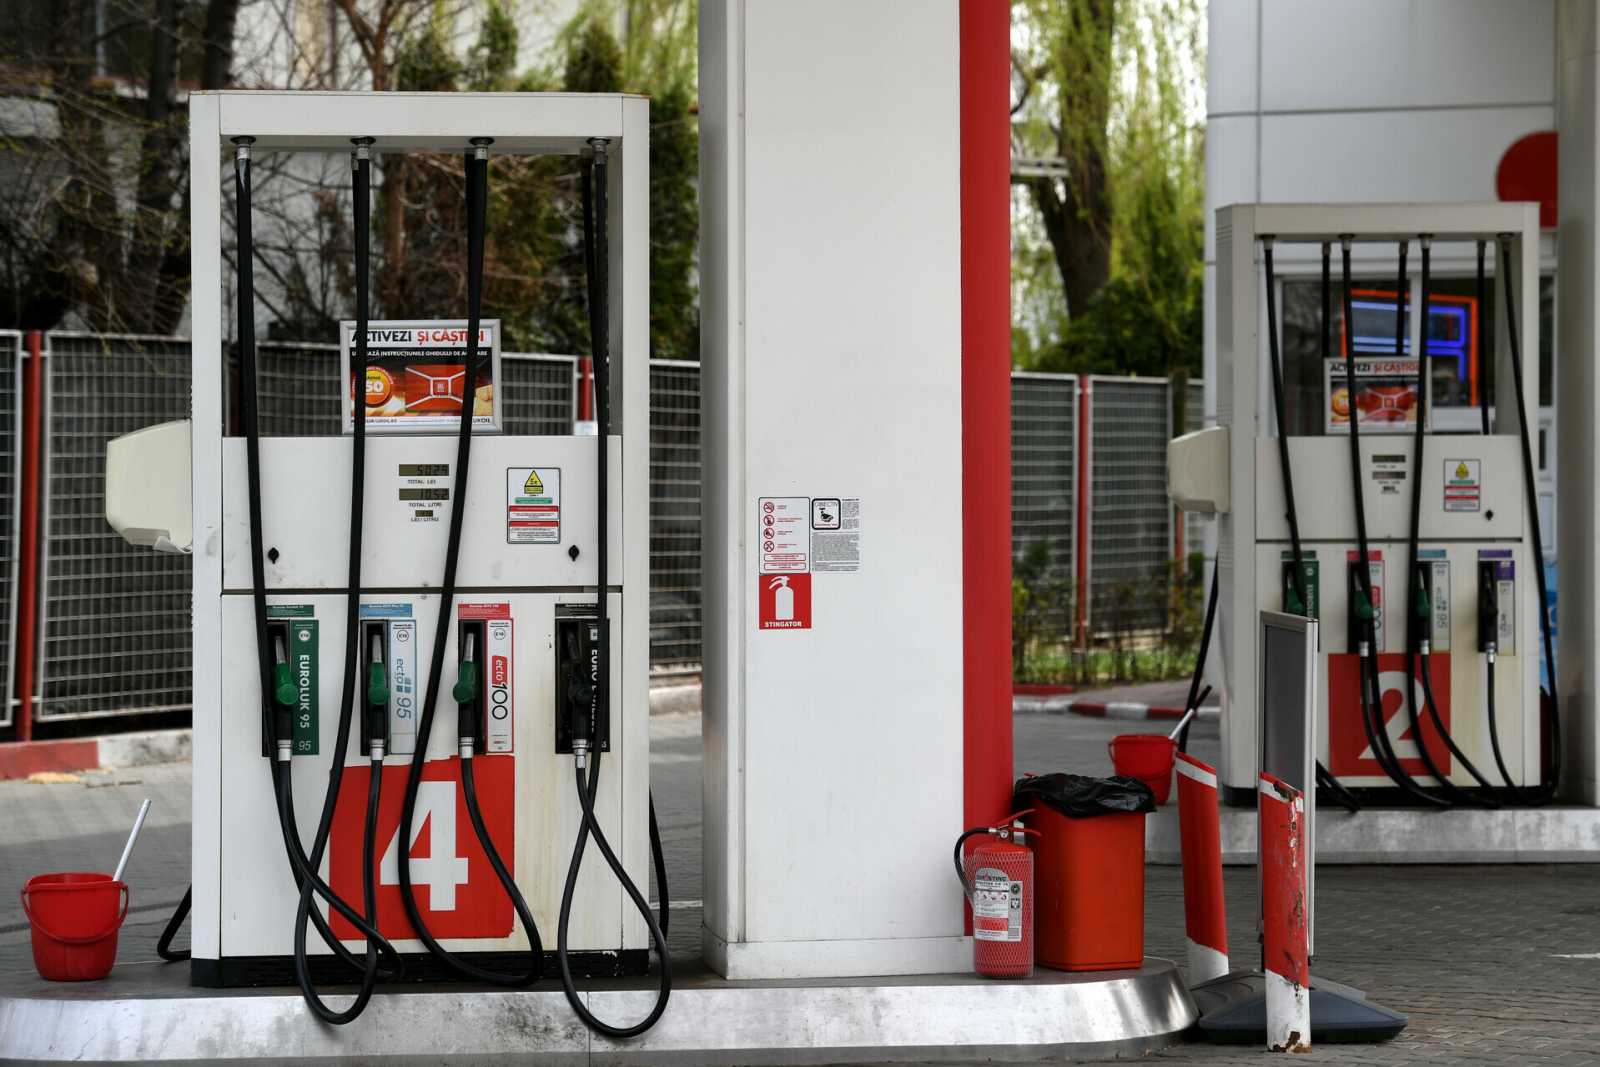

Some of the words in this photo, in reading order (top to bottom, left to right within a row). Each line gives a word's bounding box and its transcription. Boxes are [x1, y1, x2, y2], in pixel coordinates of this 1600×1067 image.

[352, 330, 412, 342] TIVEZI
[432, 328, 484, 346] CÂȘTII
[495, 659, 504, 682] ecto
[299, 654, 310, 711] EUROLUK
[396, 697, 412, 719] 95
[491, 683, 508, 720] 100
[299, 713, 310, 729] 95
[1358, 670, 1425, 760] 2
[299, 741, 311, 751] 95
[379, 780, 469, 911] 4
